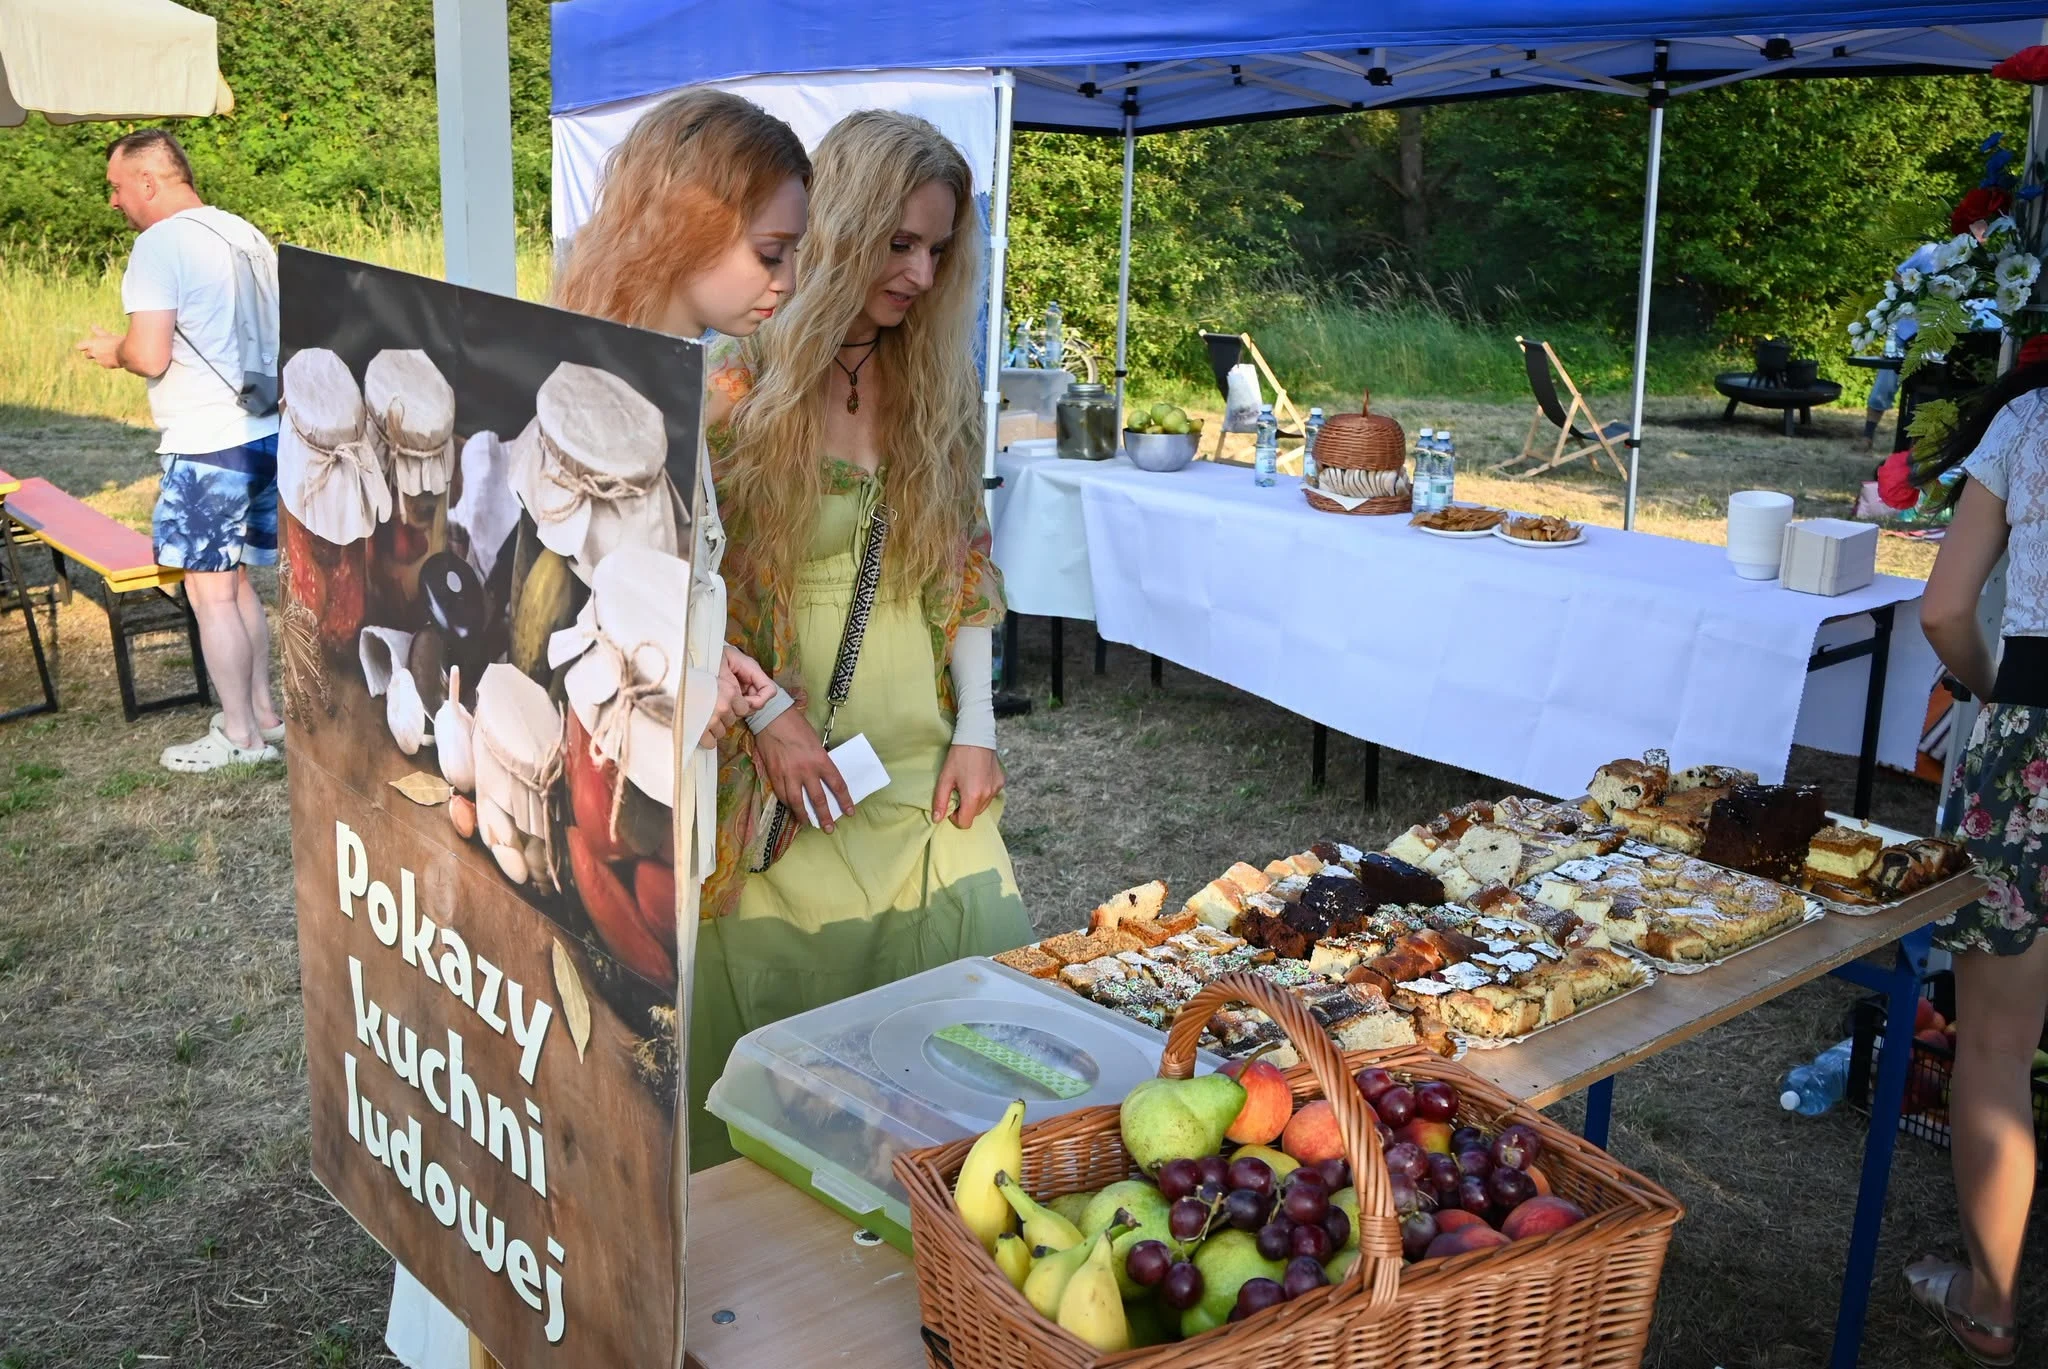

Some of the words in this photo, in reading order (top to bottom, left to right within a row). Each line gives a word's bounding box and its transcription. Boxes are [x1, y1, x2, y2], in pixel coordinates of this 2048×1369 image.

[335, 820, 552, 1085] Pokazy
[348, 955, 548, 1199] kuchni
[344, 1051, 565, 1343] ludowej
